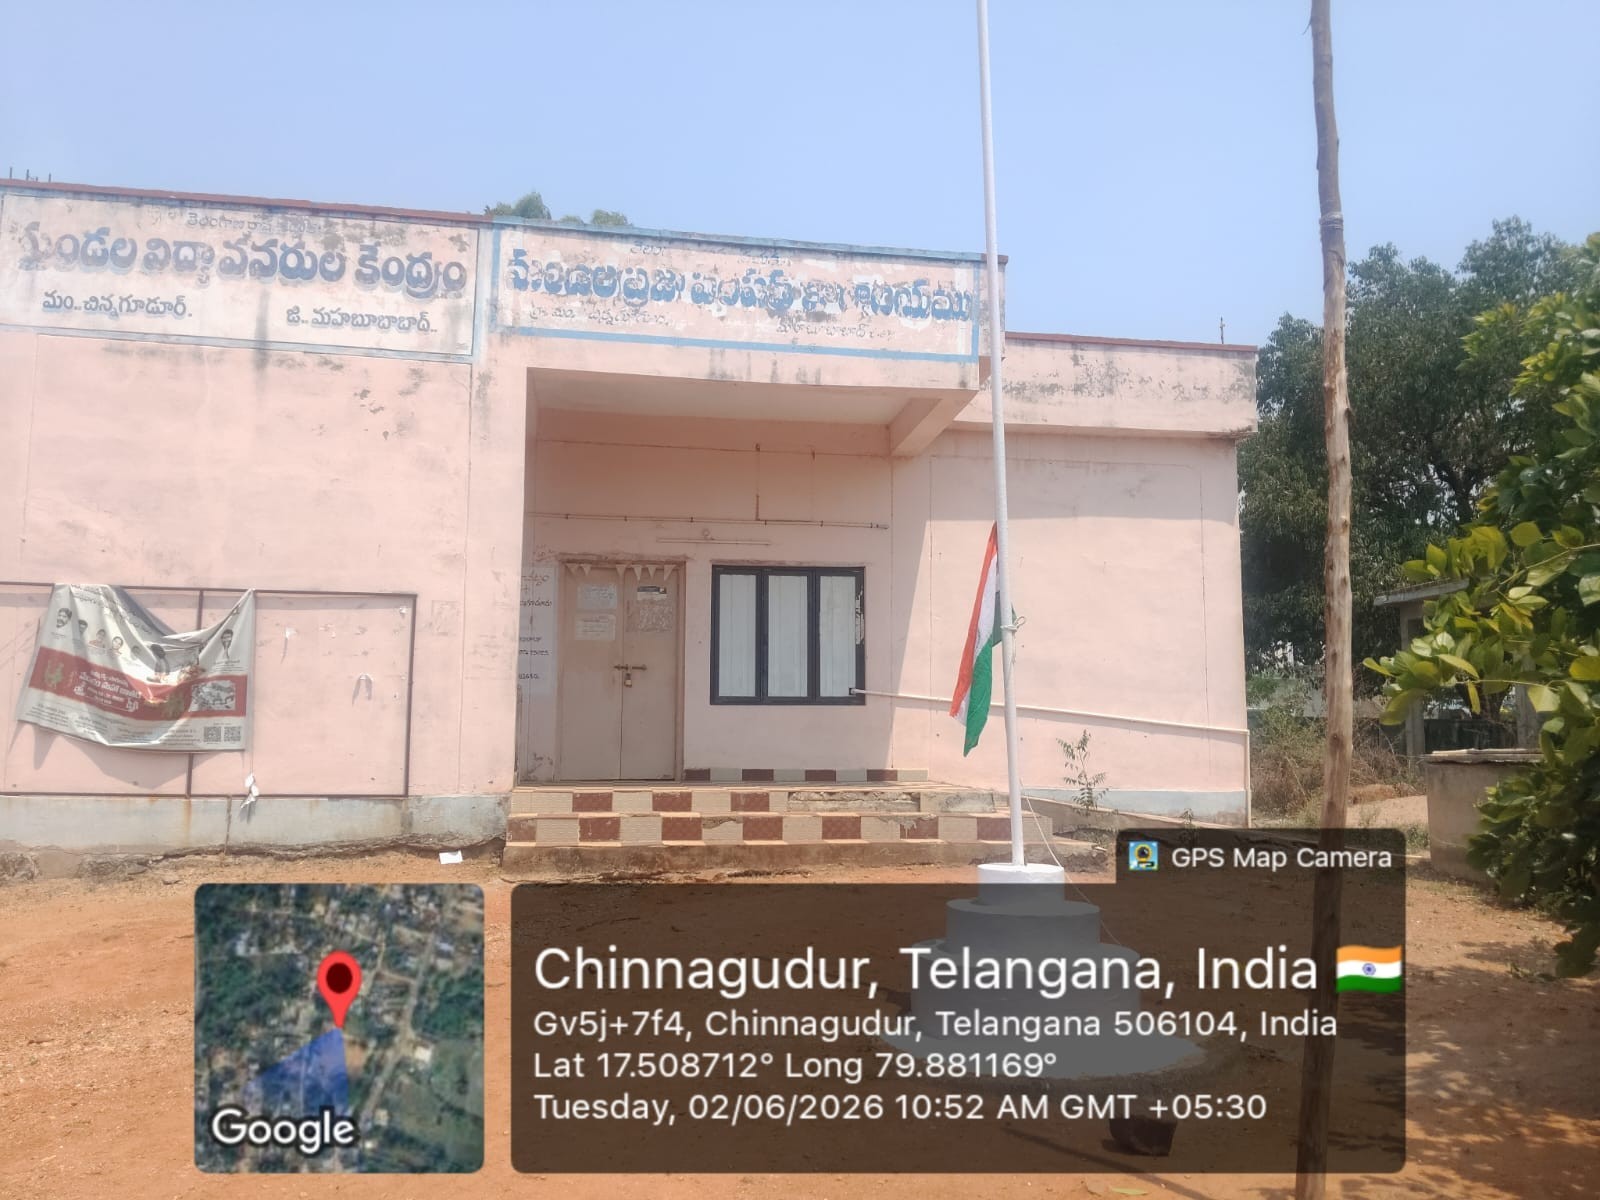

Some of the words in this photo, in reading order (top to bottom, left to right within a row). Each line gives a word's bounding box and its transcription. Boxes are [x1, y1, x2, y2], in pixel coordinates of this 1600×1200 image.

[142, 237, 216, 285] విద్యా
[217, 237, 347, 283] వనరుల
[354, 241, 467, 300] కేంద్రం
